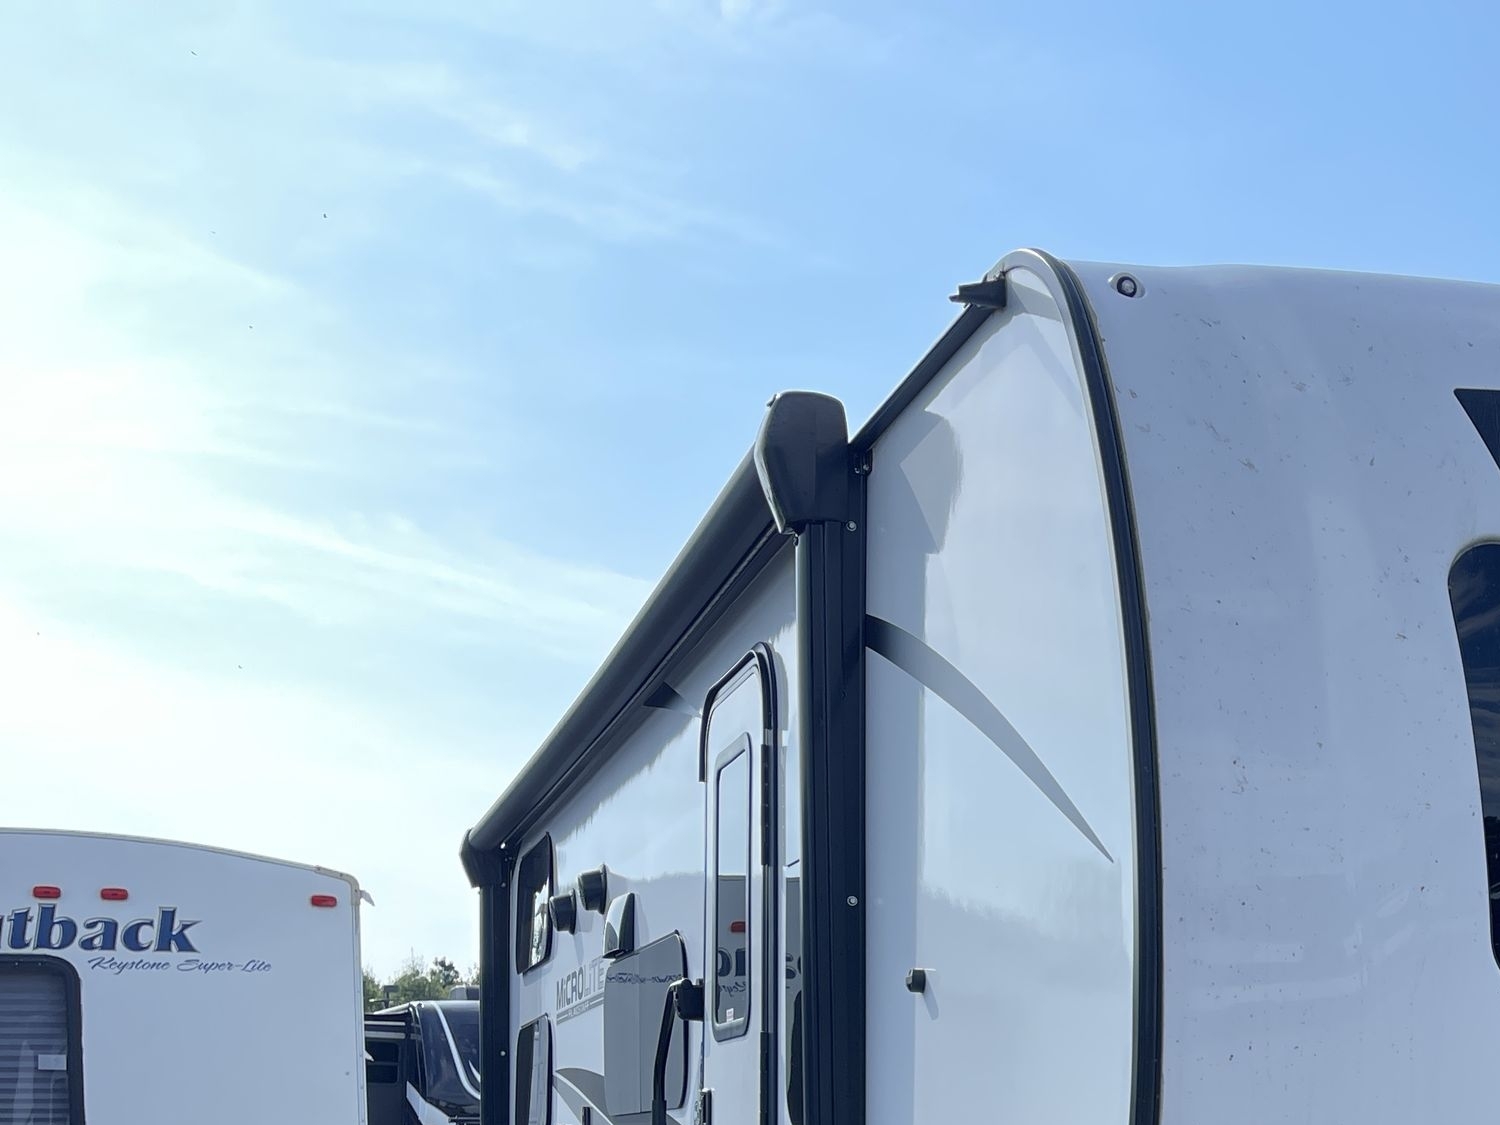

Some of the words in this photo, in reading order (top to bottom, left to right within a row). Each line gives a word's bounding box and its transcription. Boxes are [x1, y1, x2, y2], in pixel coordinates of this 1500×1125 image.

[0, 902, 203, 954] tback
[87, 956, 171, 975] Keystone
[177, 958, 273, 974] Super-Lite
